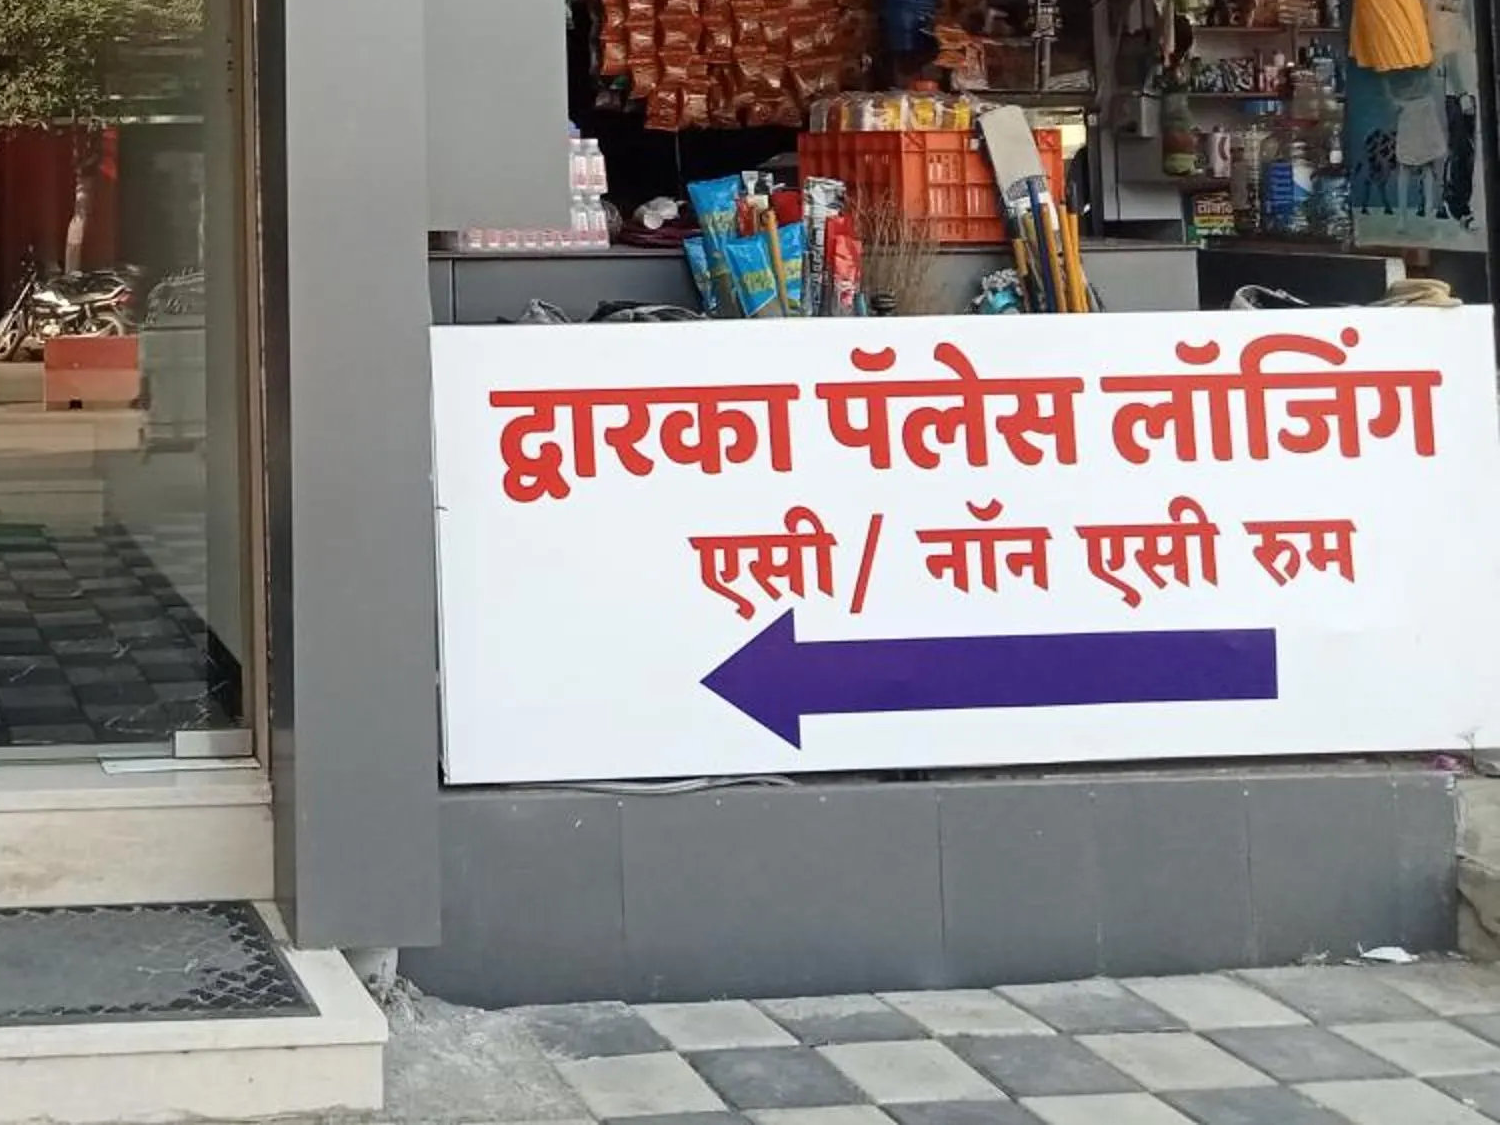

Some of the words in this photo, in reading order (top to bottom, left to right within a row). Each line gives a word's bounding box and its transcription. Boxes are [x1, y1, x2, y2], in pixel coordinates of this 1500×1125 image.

[489, 383, 799, 504] द्वारका
[815, 342, 1084, 469] पॅलेस
[1100, 327, 1442, 465] लॉजिंग
[915, 498, 1053, 594] नॉन
[1074, 495, 1221, 609] एसी
